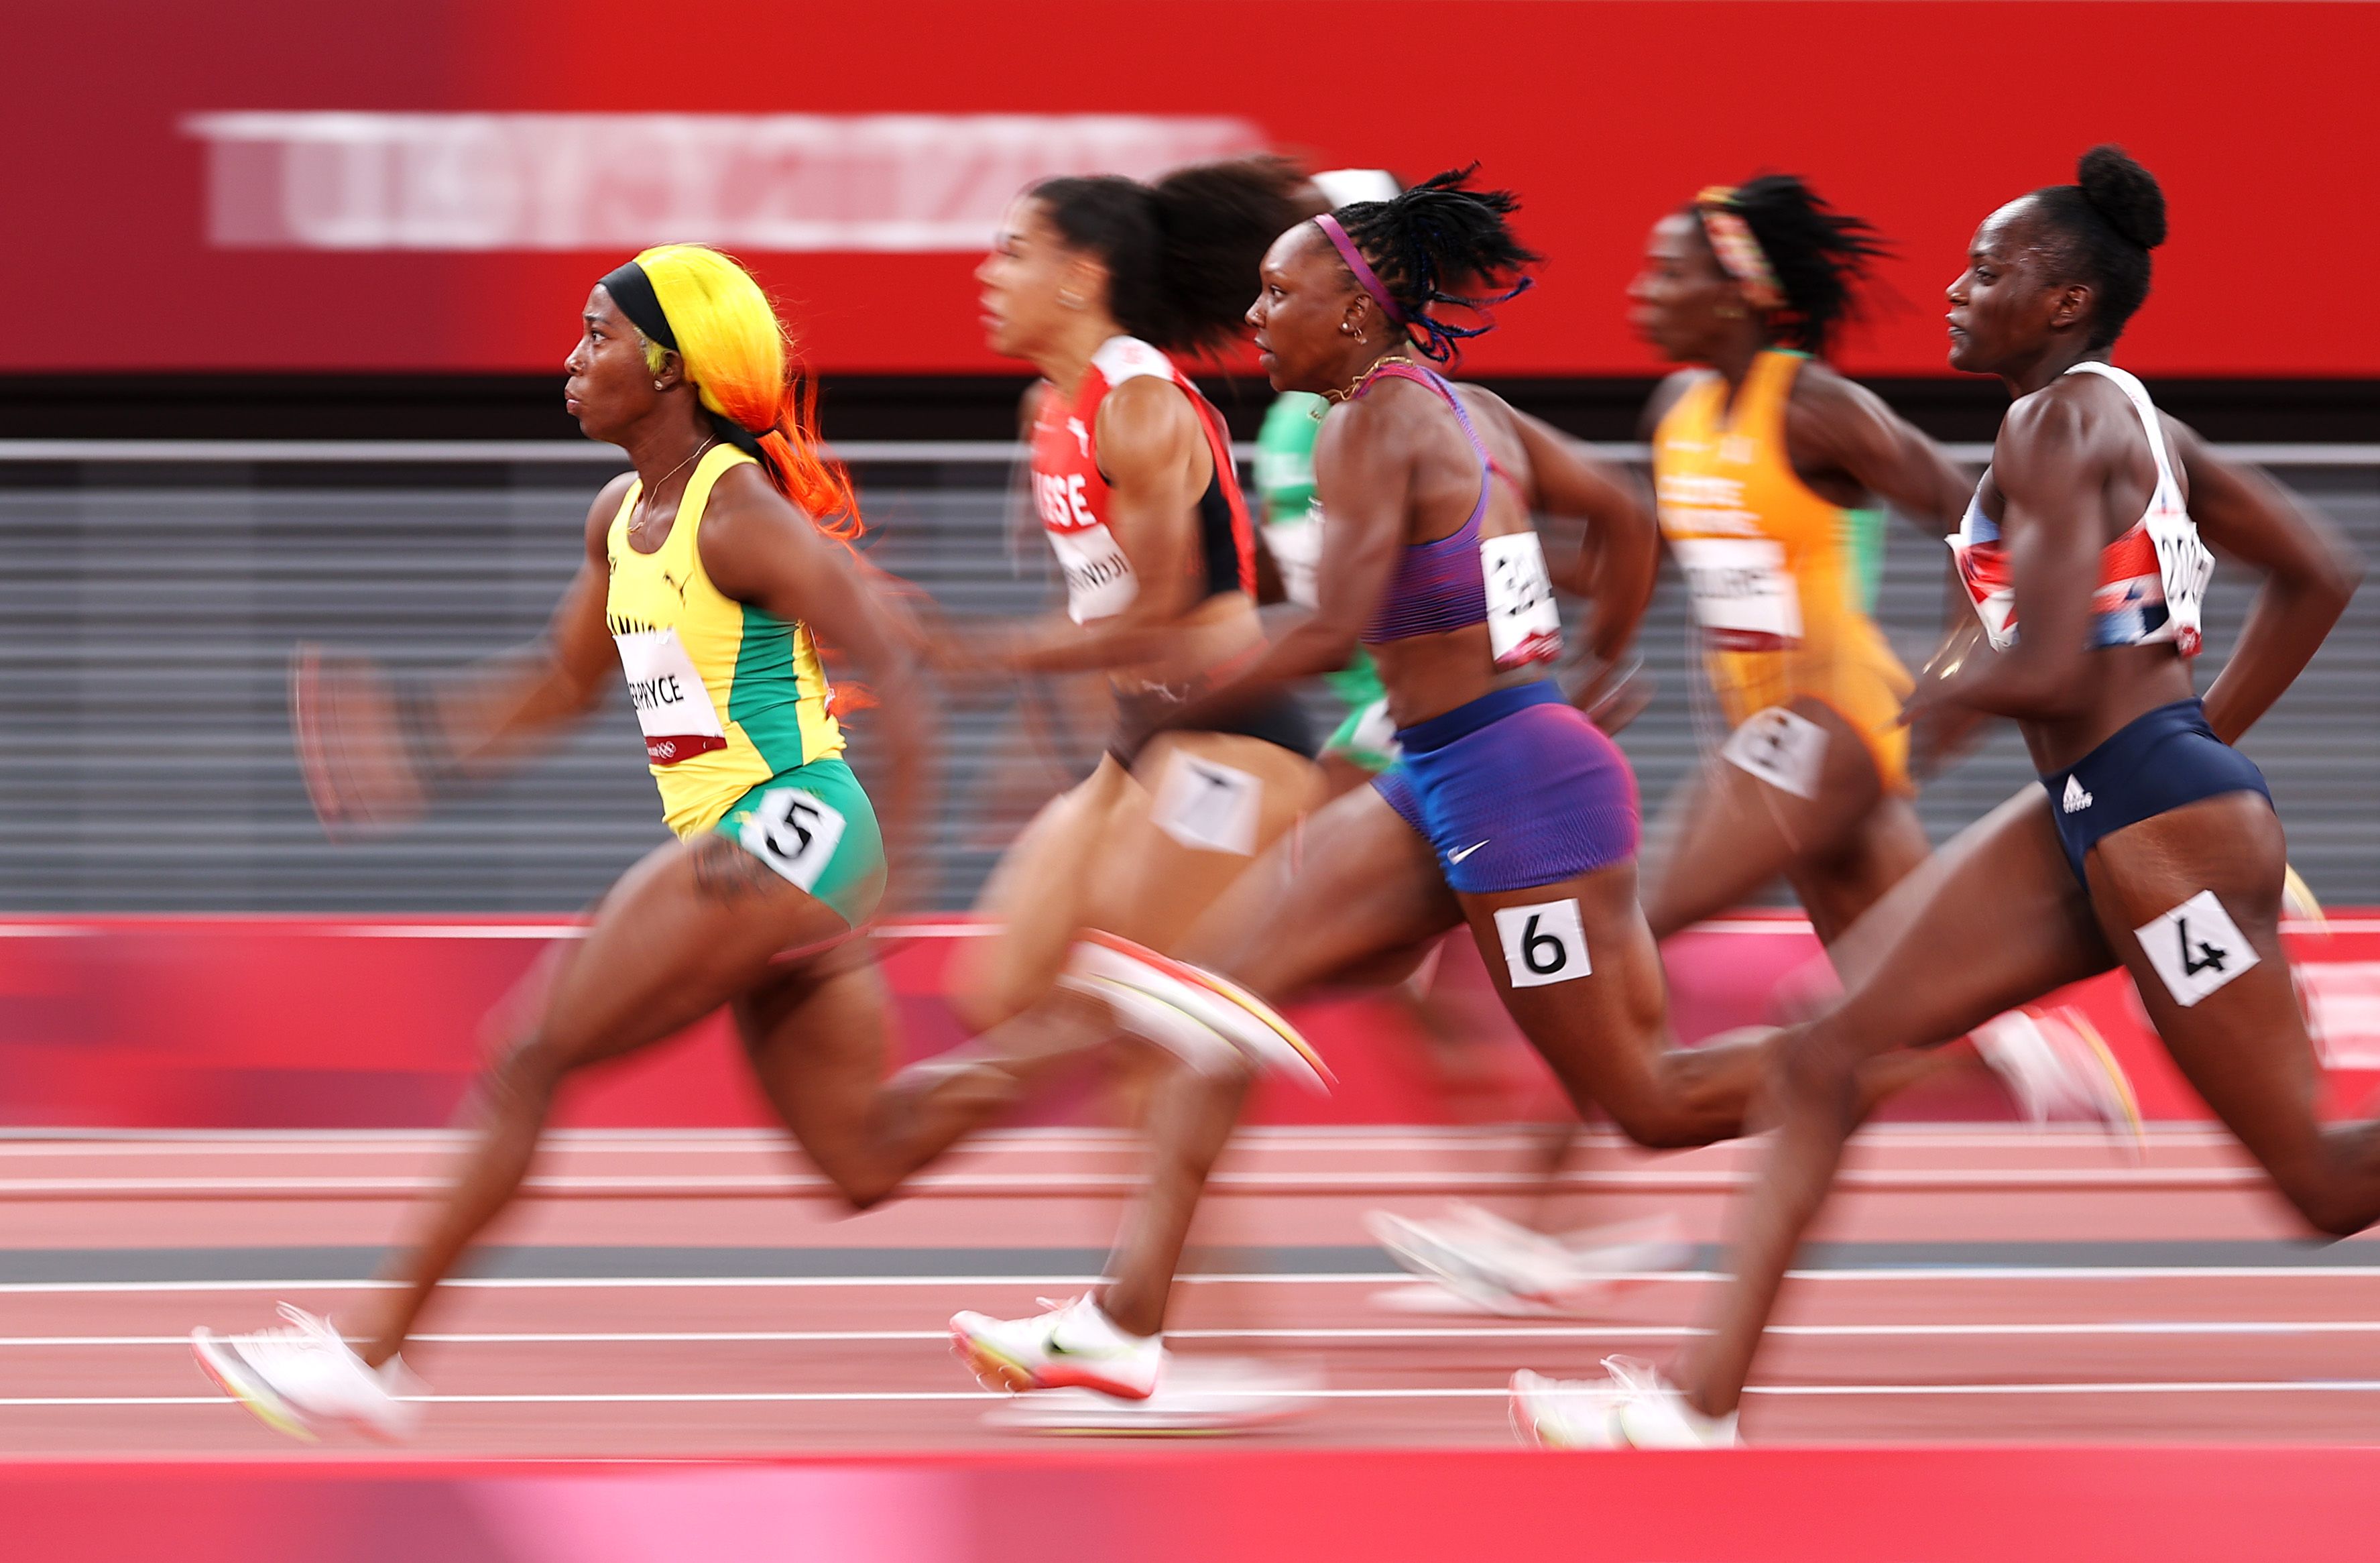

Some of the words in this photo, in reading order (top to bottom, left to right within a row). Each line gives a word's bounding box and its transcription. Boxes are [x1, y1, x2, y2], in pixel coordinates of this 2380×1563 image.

[766, 801, 821, 860] 5
[1522, 913, 1566, 974] 6
[2179, 918, 2226, 976] 4
